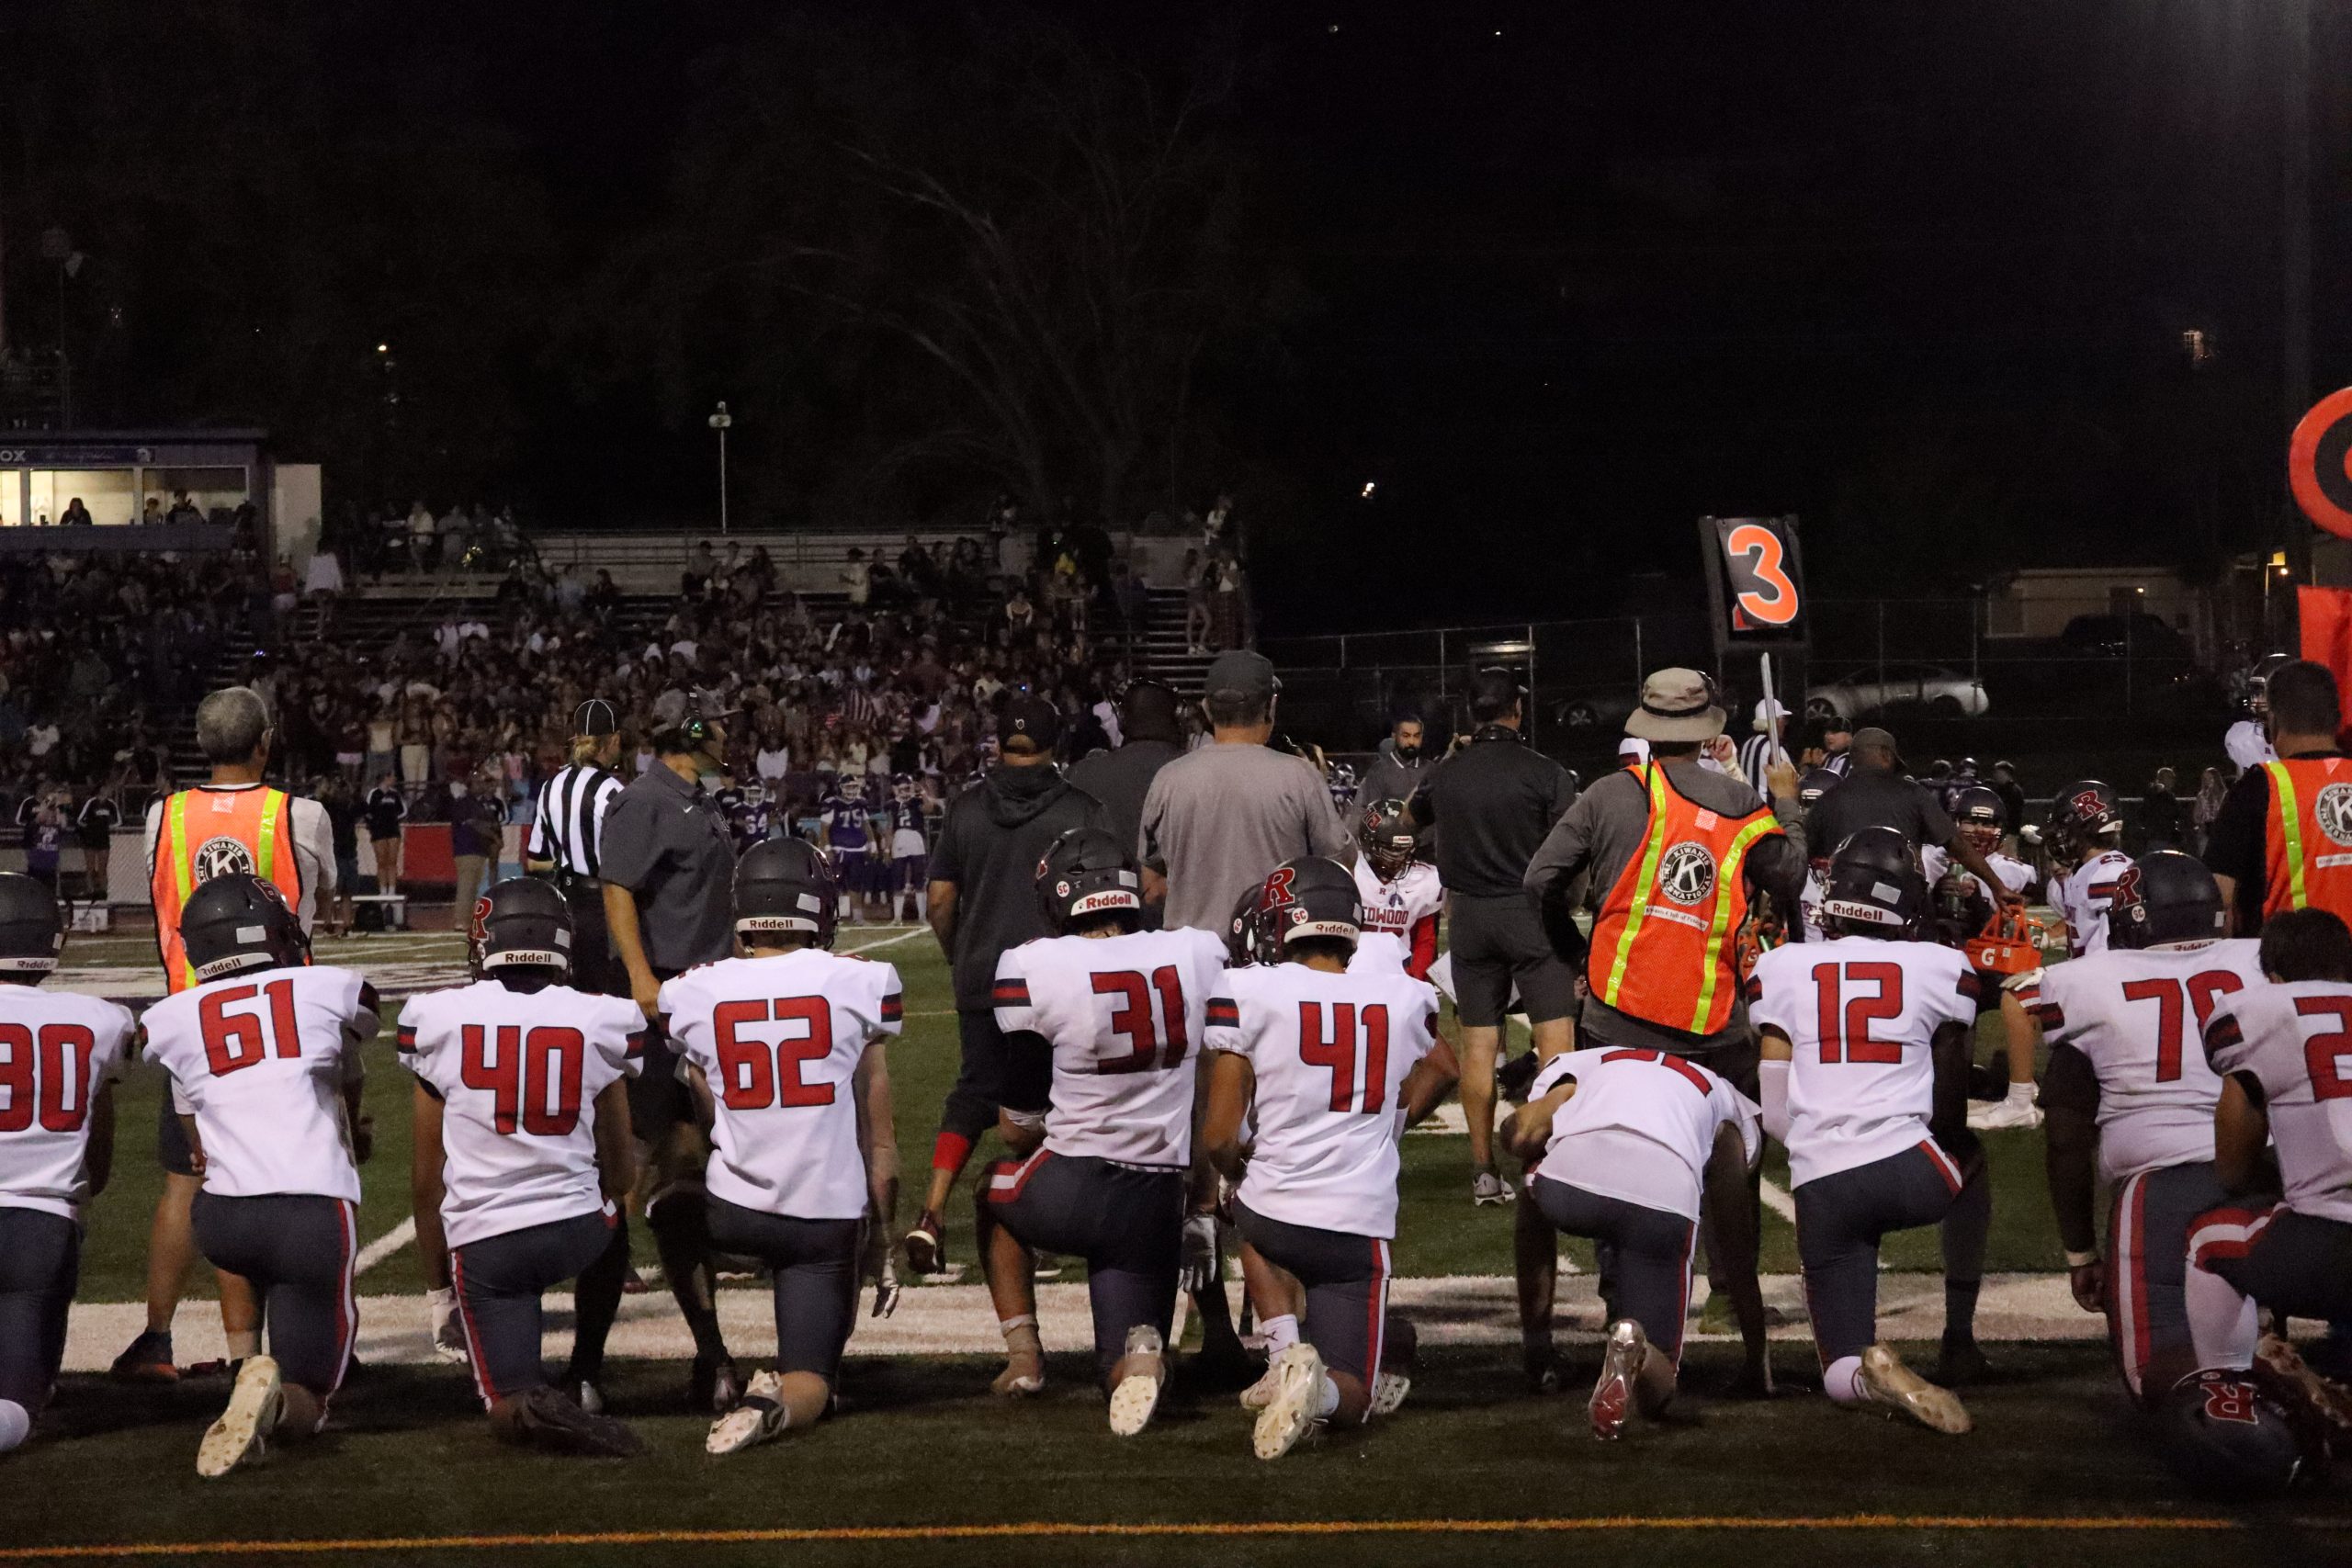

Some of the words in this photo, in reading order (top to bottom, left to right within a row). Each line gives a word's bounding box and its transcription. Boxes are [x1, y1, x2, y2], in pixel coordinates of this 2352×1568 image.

[1728, 525, 1798, 624] 3
[839, 808, 862, 828] 75
[2071, 790, 2107, 821] R
[202, 841, 243, 857] KIWANIS
[1673, 847, 1711, 866] KIWANIS
[210, 850, 235, 878] K
[1673, 854, 1703, 890] K
[1057, 884, 1069, 895] SC
[1086, 894, 1132, 909] Riddell
[1259, 867, 1295, 913] R
[2114, 868, 2142, 911] R
[469, 897, 493, 942] R
[750, 919, 794, 929] Riddell
[1293, 909, 1306, 921] SC
[1832, 903, 1883, 922] Riddell
[2132, 908, 2144, 919] SC
[1316, 923, 1355, 935] Riddell
[200, 958, 242, 976] Riddell
[505, 953, 551, 964] Riddell
[1982, 948, 1996, 966] G
[1090, 964, 1188, 1075] 31
[1812, 962, 1903, 1064] 12
[199, 978, 301, 1077] 61
[713, 995, 835, 1110] 62
[1298, 1000, 1389, 1114] 41
[460, 1024, 584, 1136] 40
[2199, 1382, 2258, 1425] R
